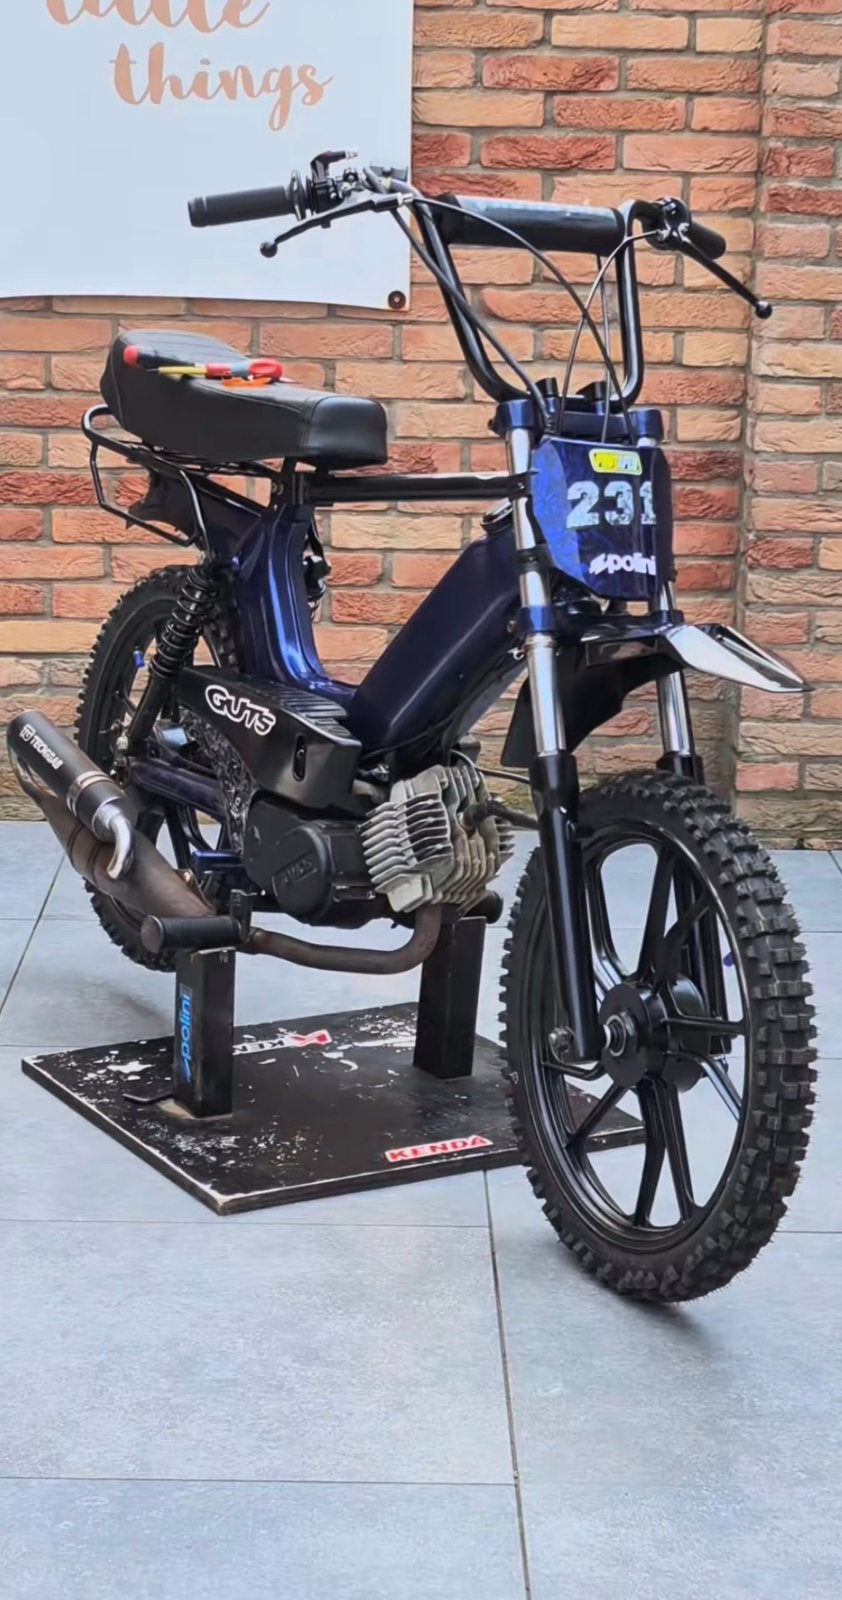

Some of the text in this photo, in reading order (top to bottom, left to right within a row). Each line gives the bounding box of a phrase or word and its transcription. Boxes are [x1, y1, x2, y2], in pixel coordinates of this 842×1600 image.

[109, 41, 333, 131] things
[567, 481, 656, 528] 231
[606, 552, 656, 575] polini
[205, 684, 276, 736] GUTS
[180, 994, 192, 1060] polini
[233, 1039, 285, 1054] KEN
[390, 1137, 487, 1160] KENDA
